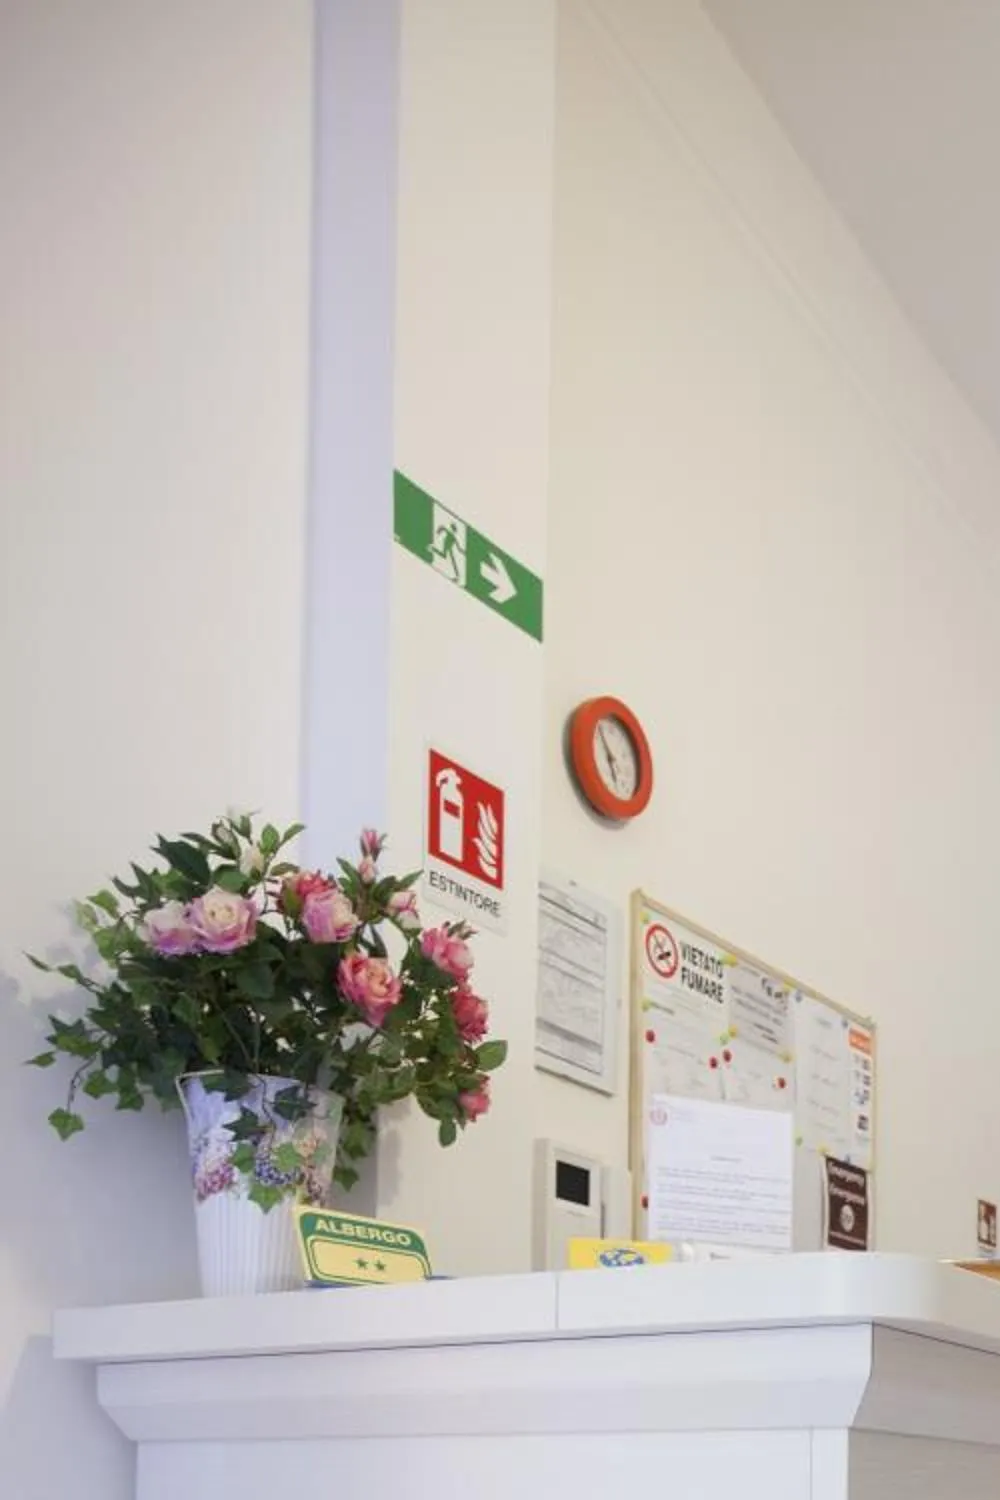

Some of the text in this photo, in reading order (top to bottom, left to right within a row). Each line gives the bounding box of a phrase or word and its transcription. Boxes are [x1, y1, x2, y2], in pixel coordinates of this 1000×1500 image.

[429, 871, 501, 917] ESTINTORE
[681, 942, 724, 979] VIETATO
[681, 967, 724, 1004] FUMARE
[316, 1219, 412, 1246] ALBERGO
